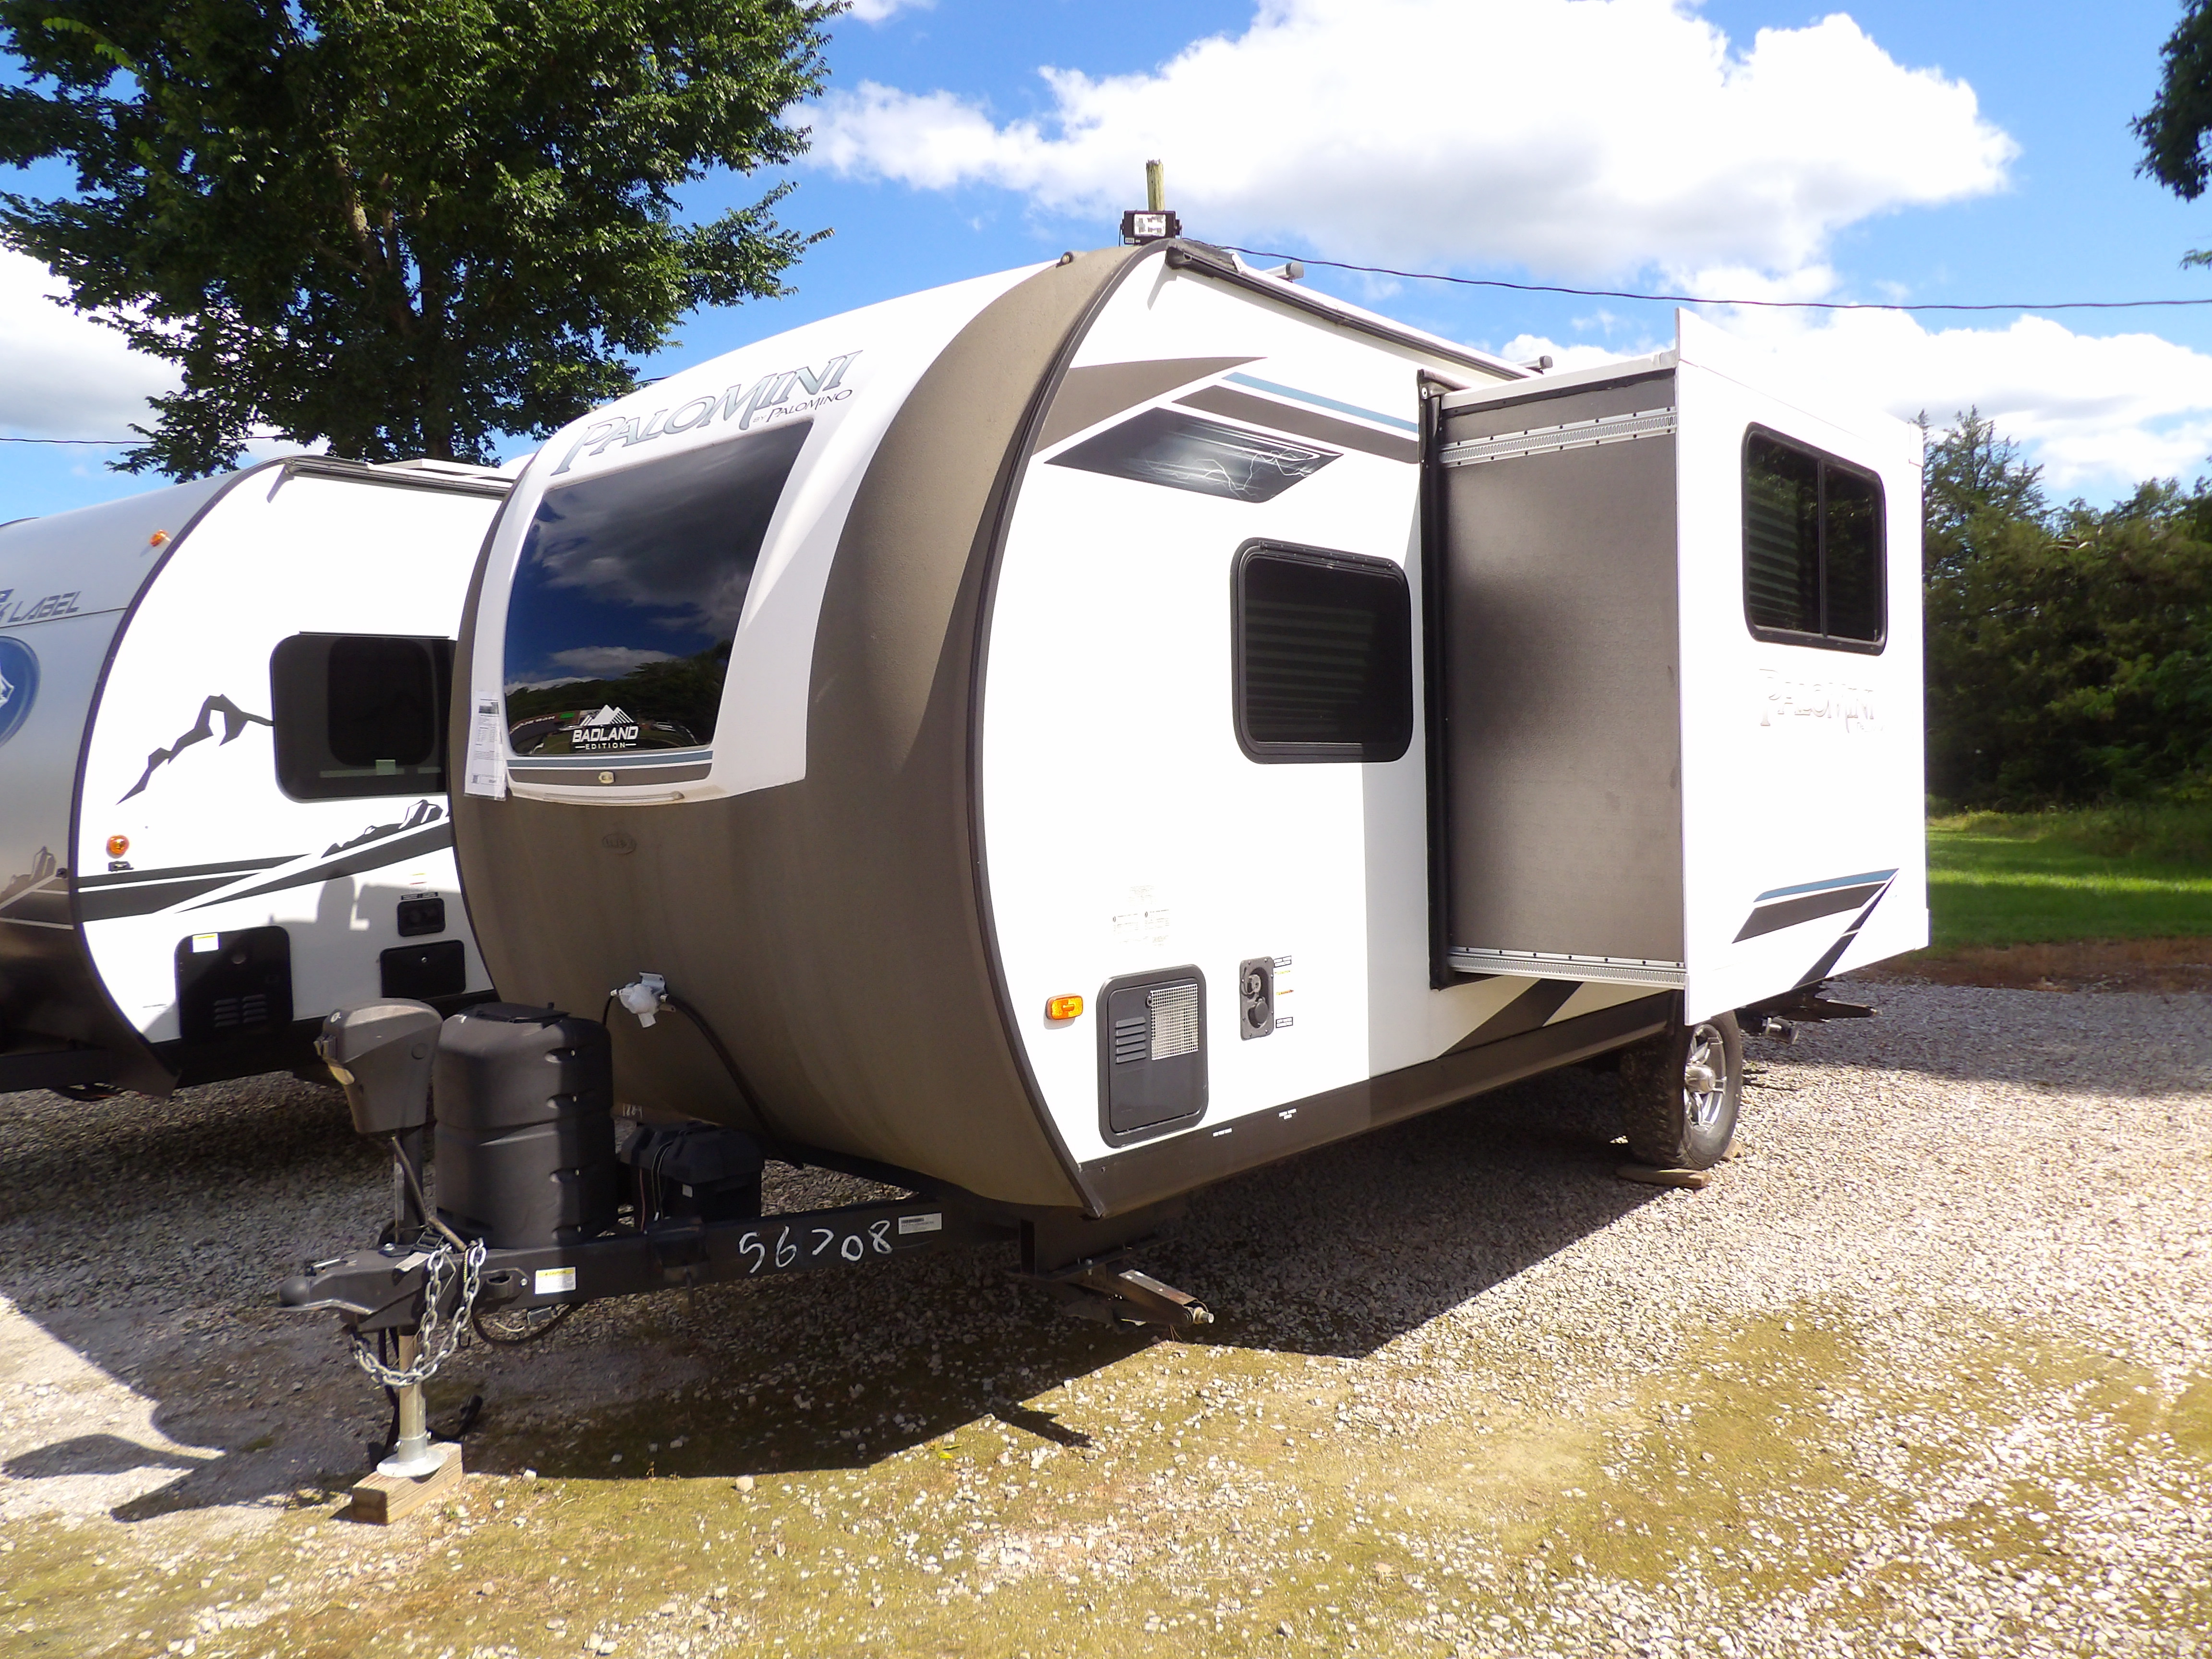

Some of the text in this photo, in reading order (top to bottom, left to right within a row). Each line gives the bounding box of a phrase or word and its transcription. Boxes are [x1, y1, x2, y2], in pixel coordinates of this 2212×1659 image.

[551, 350, 863, 476] PALOMINI
[765, 389, 853, 423] PALOMINO
[8, 591, 81, 623] LABEL
[572, 725, 639, 743] BADLAND
